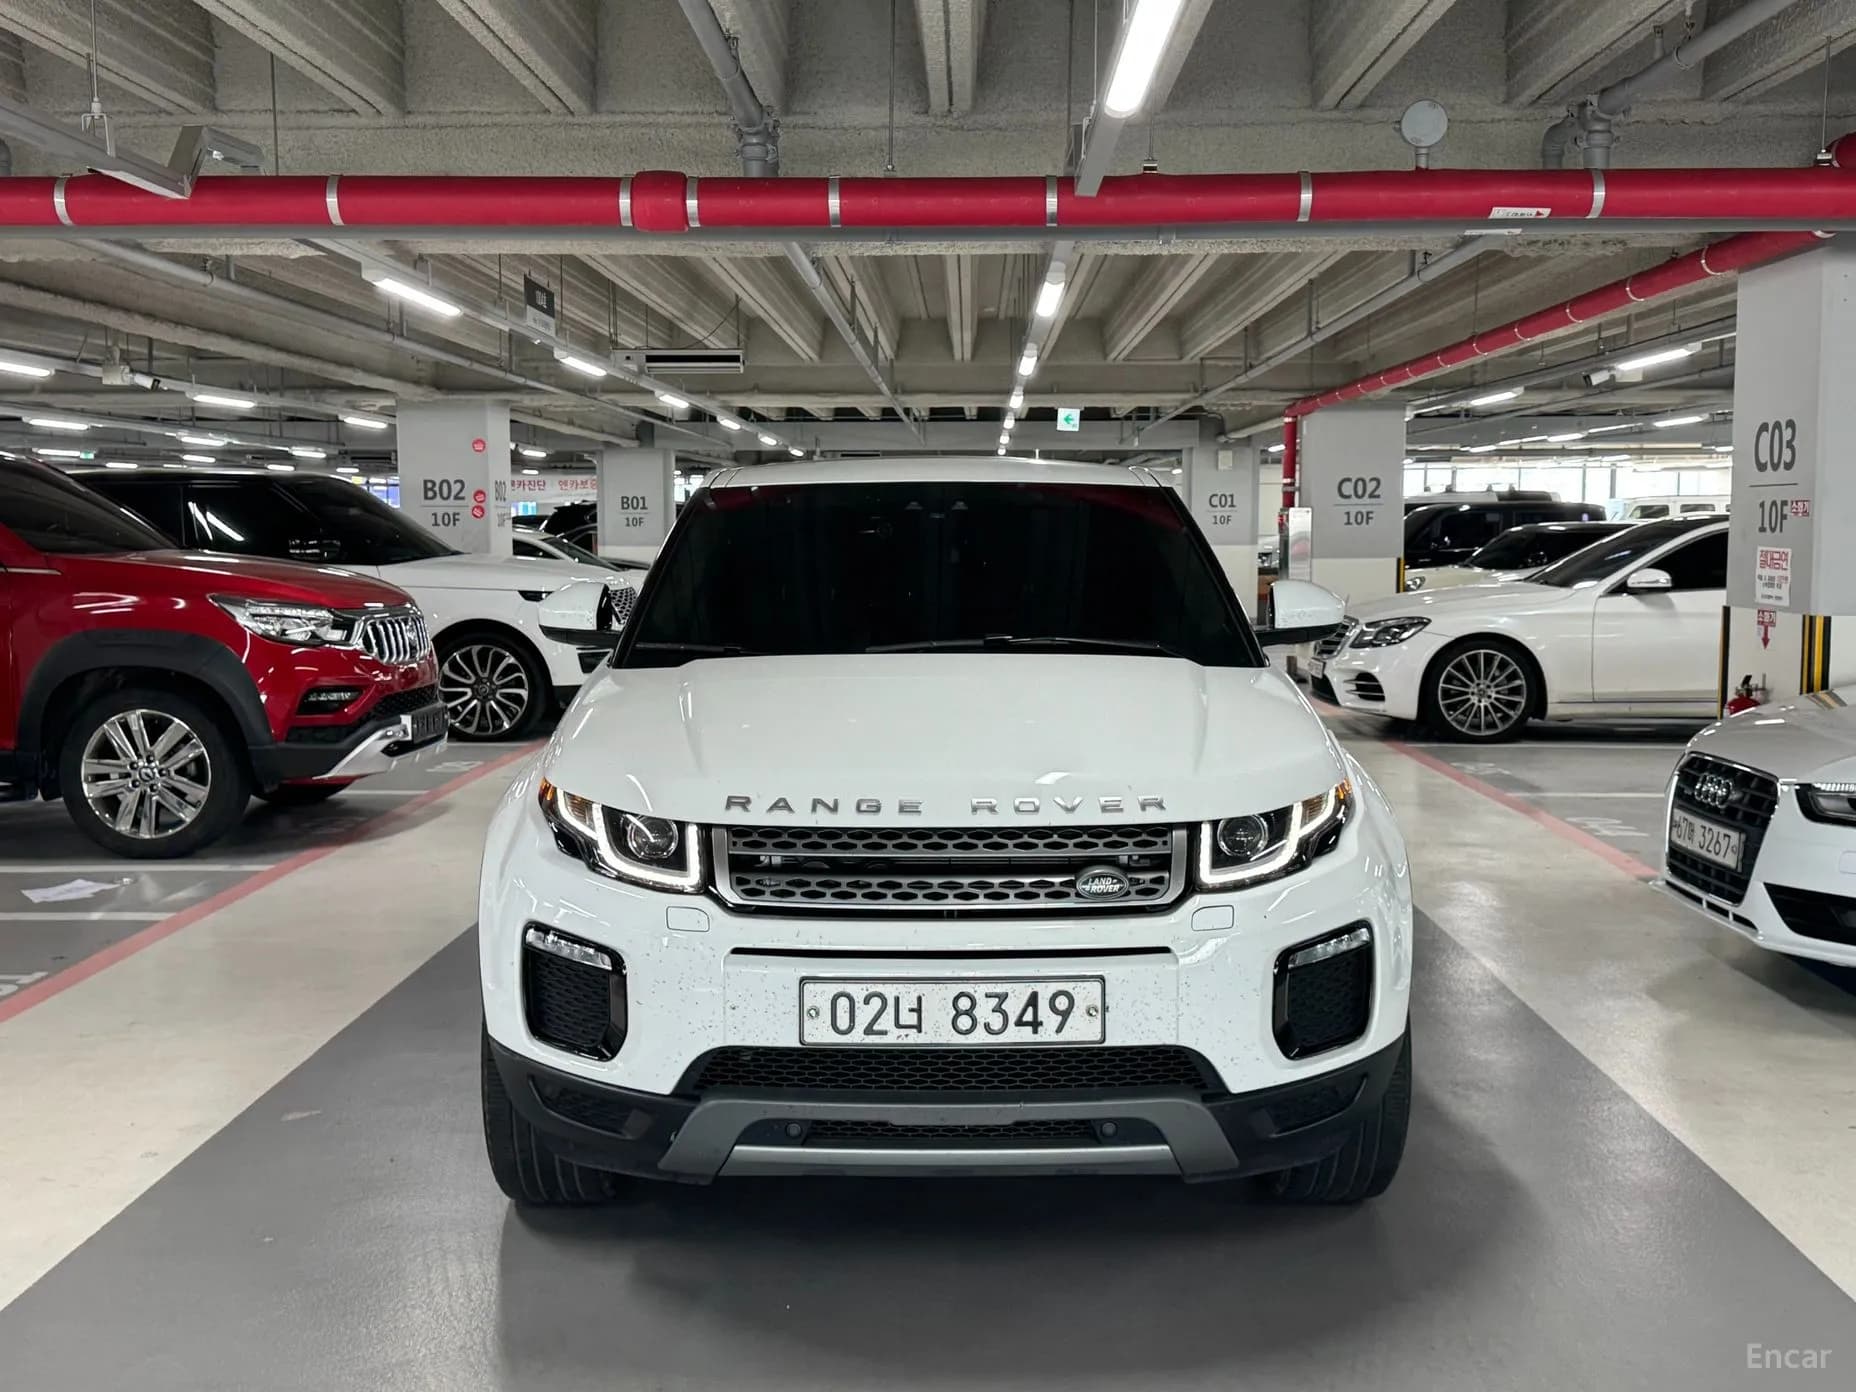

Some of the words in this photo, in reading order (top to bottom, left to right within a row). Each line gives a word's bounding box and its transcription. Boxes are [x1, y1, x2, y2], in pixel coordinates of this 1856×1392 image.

[1754, 418, 1797, 473] C03
[422, 478, 466, 501] B02
[1337, 477, 1382, 500] C02
[620, 495, 648, 510] B01
[1208, 493, 1237, 509] C01
[431, 511, 461, 527] 10F
[625, 516, 645, 528] 10F
[1212, 514, 1233, 525] 10F
[1343, 510, 1375, 526] 10F
[1758, 499, 1788, 534] 10F
[725, 795, 924, 814] RANGE
[971, 794, 1168, 814] ROVER
[1698, 824, 1732, 859] 3267
[1087, 877, 1113, 886] LAND
[1090, 884, 1120, 893] ROVER
[830, 990, 923, 1036] 02너
[951, 989, 1075, 1036] 8349
